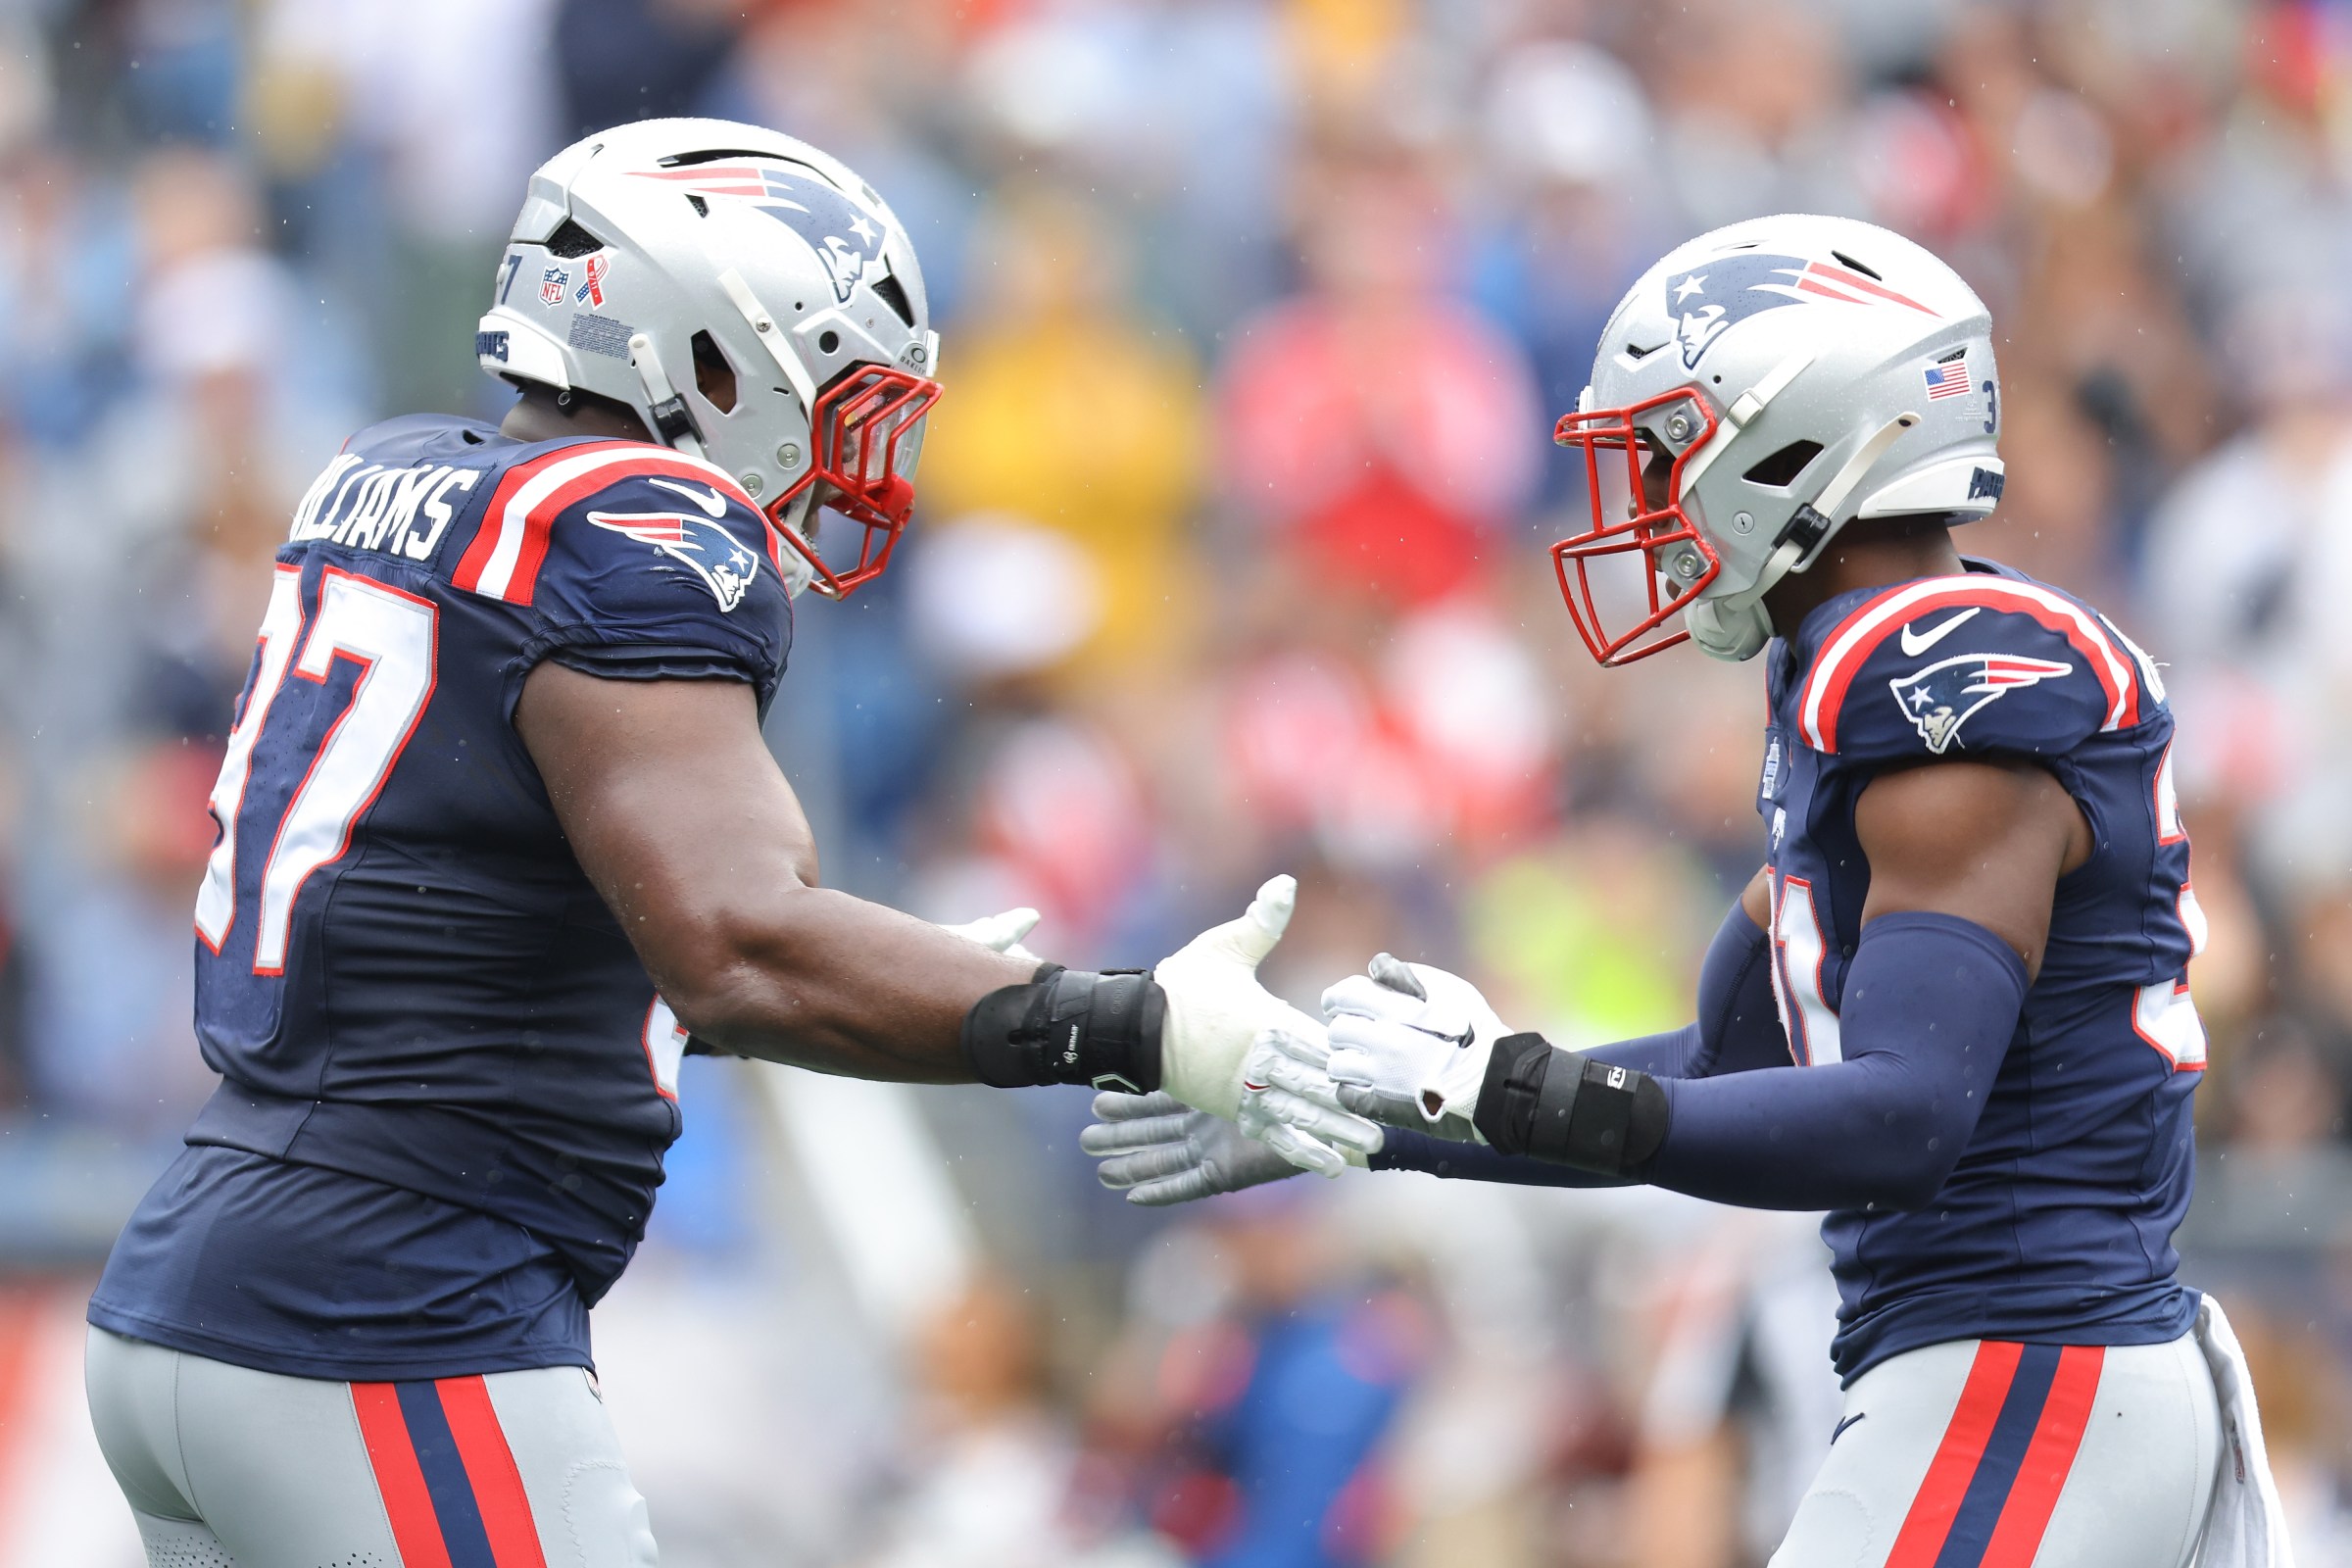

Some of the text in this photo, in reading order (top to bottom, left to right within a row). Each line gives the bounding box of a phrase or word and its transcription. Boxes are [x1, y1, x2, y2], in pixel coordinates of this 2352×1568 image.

[588, 271, 598, 290] 9/11
[542, 282, 562, 301] NFL
[900, 356, 926, 374] OAKLEY
[1983, 380, 1996, 433] 3
[288, 453, 480, 562] ILLIAMS
